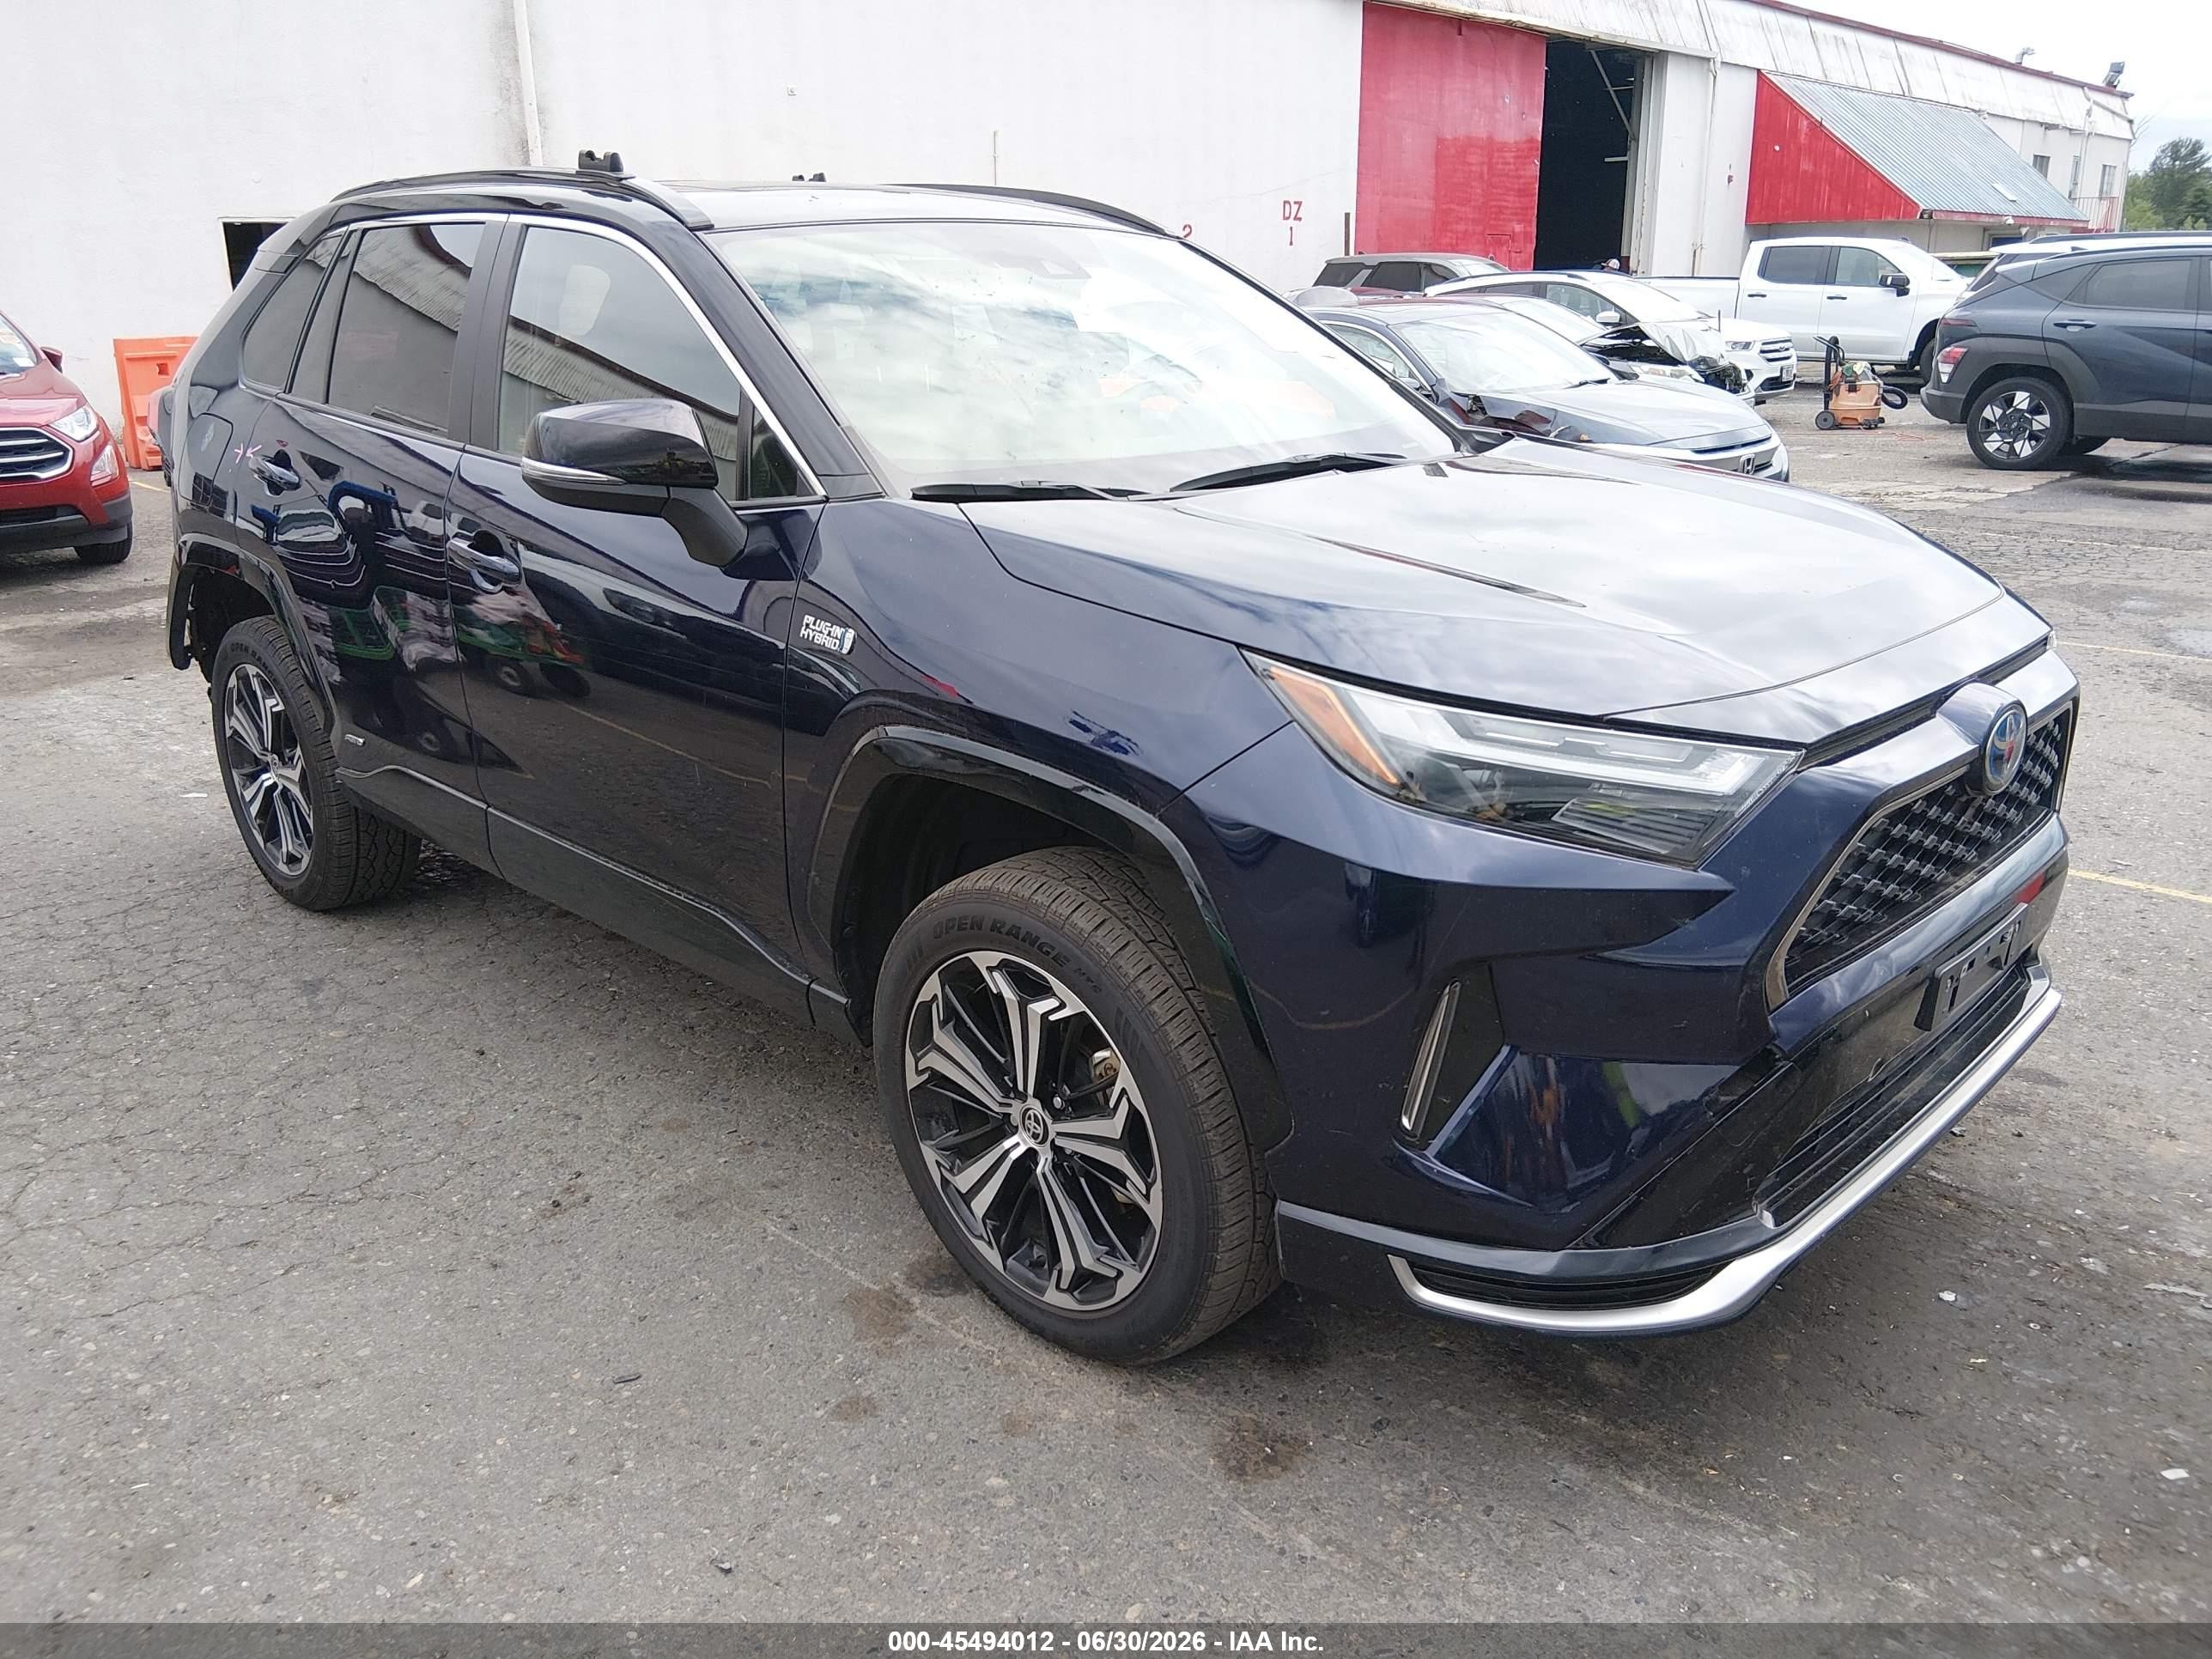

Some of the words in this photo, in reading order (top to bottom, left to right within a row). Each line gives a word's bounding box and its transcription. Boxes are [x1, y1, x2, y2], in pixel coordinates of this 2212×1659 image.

[1282, 200, 1304, 222] DZ
[1182, 223, 1193, 239] 2
[799, 626, 841, 650] HYBRID
[933, 915, 985, 939] OPEN
[989, 918, 1072, 968] RANGE
